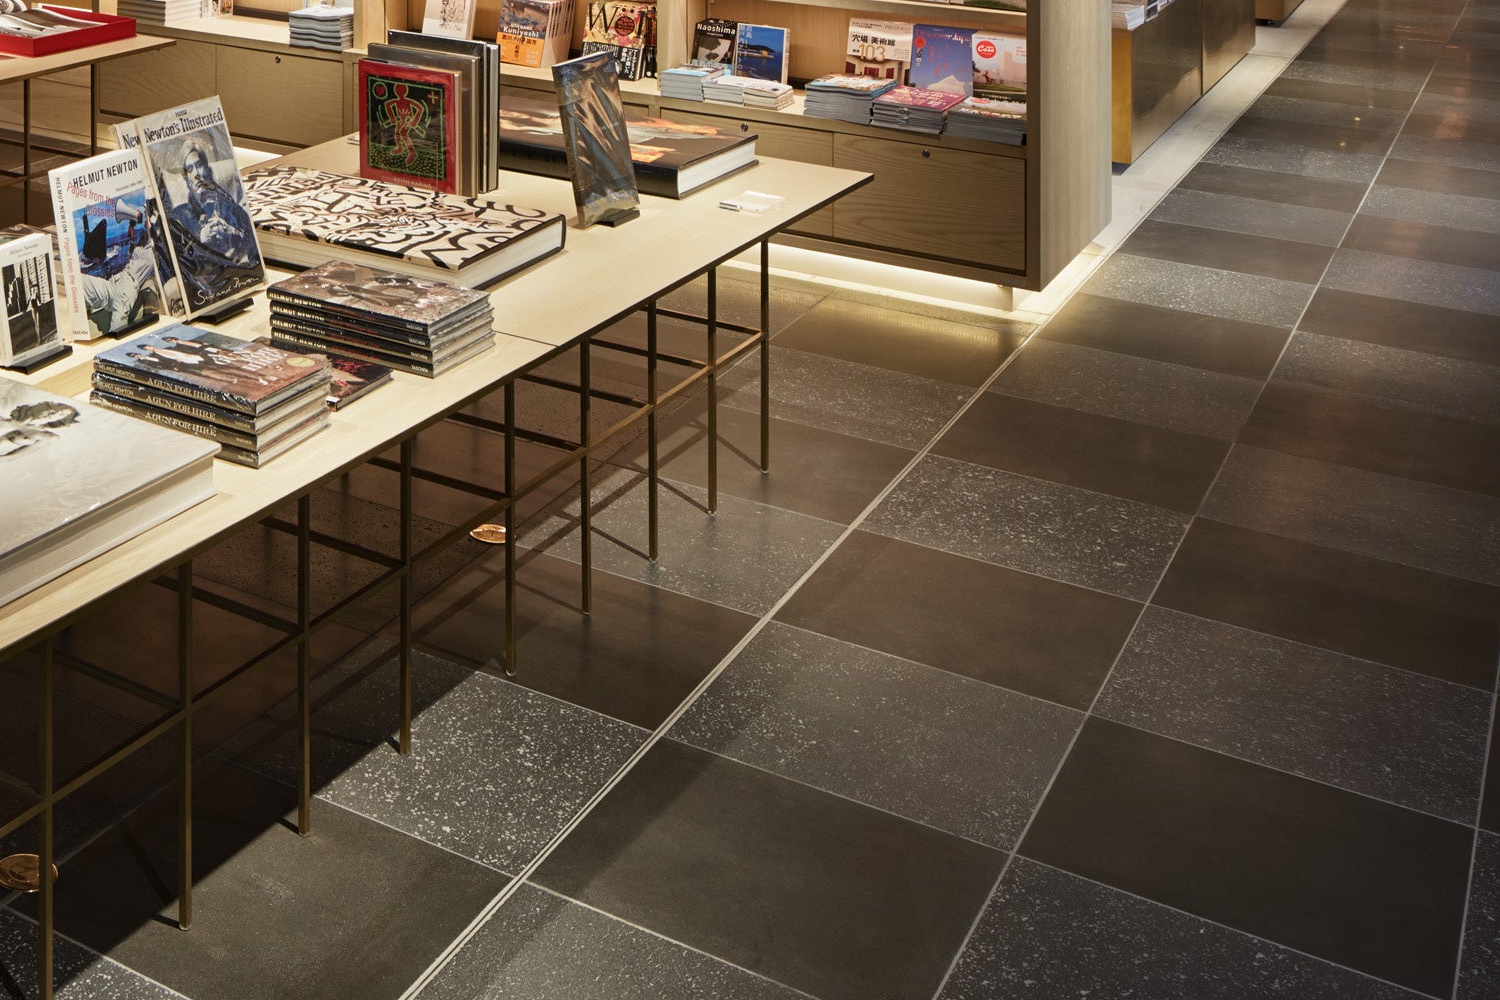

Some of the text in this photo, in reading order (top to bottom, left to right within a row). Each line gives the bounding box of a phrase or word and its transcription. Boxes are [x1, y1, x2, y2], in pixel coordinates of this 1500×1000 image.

[502, 26, 540, 38] Kuniyoshi
[696, 23, 736, 35] Naoshima
[859, 44, 886, 62] 103
[143, 110, 225, 144] Newton's Illustrated
[72, 170, 106, 189] HELMUT
[106, 159, 139, 178] NEWTON
[55, 176, 64, 206] HELMUT
[67, 178, 88, 200] Pages
[88, 189, 104, 203] from
[59, 207, 69, 234] NEWTON
[70, 283, 80, 314] Glossies
[268, 292, 323, 308] HELMUT NEWTON
[272, 304, 325, 322] HELMUT NEWTON
[272, 318, 326, 335] HELMUT NEWTON
[273, 330, 327, 349] HELMUT NEWTON
[147, 378, 155, 386] A
[155, 380, 174, 391] GUN
[174, 385, 193, 396] FOR
[193, 389, 217, 403] HIRE
[146, 395, 153, 403] A
[154, 397, 172, 408] GUN
[173, 402, 191, 414] FOR
[192, 407, 216, 421] HIRE
[145, 411, 152, 419] A
[193, 423, 217, 437] HIRE
